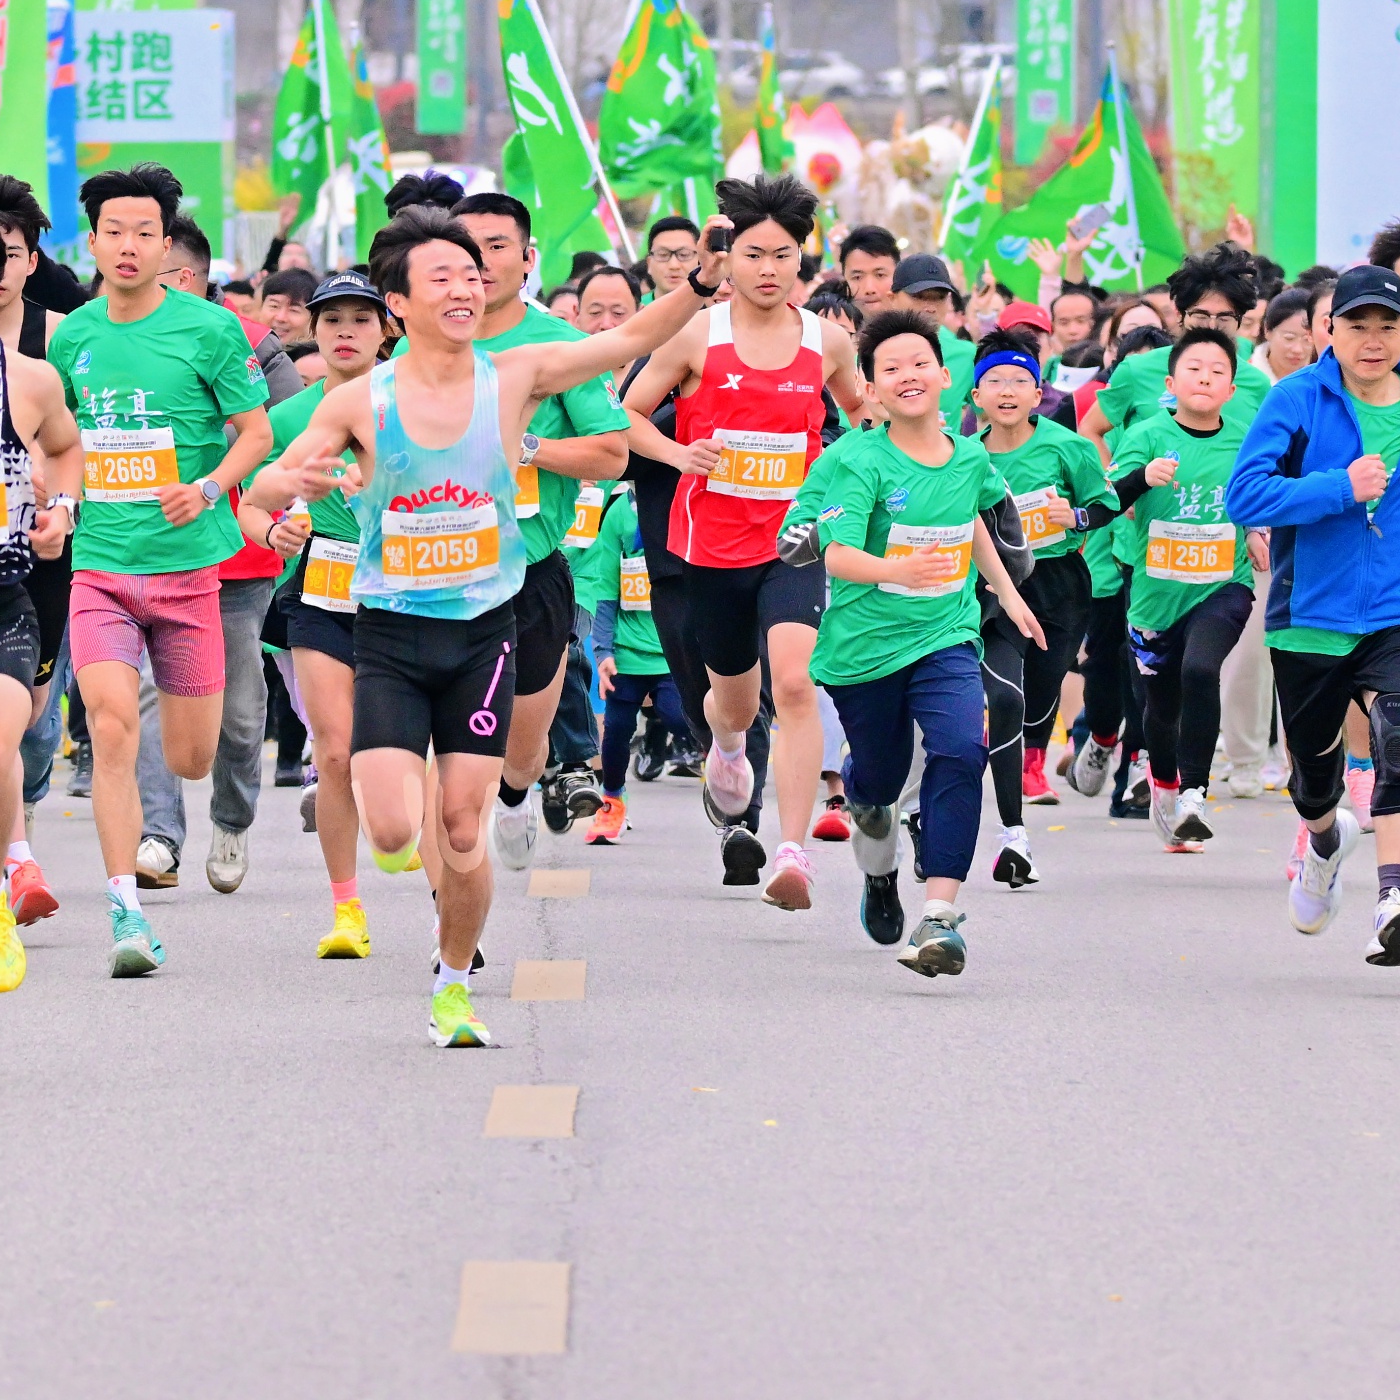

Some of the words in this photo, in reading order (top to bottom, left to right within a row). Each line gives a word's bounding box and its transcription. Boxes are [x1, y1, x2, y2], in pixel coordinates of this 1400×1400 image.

[75, 30, 173, 72] 村跑
[75, 79, 174, 121] 结区
[328, 275, 365, 288] COLORADO
[104, 455, 157, 484] 2669
[741, 456, 787, 482] 2110
[415, 537, 478, 569] 2059
[1175, 544, 1218, 567] 2516
